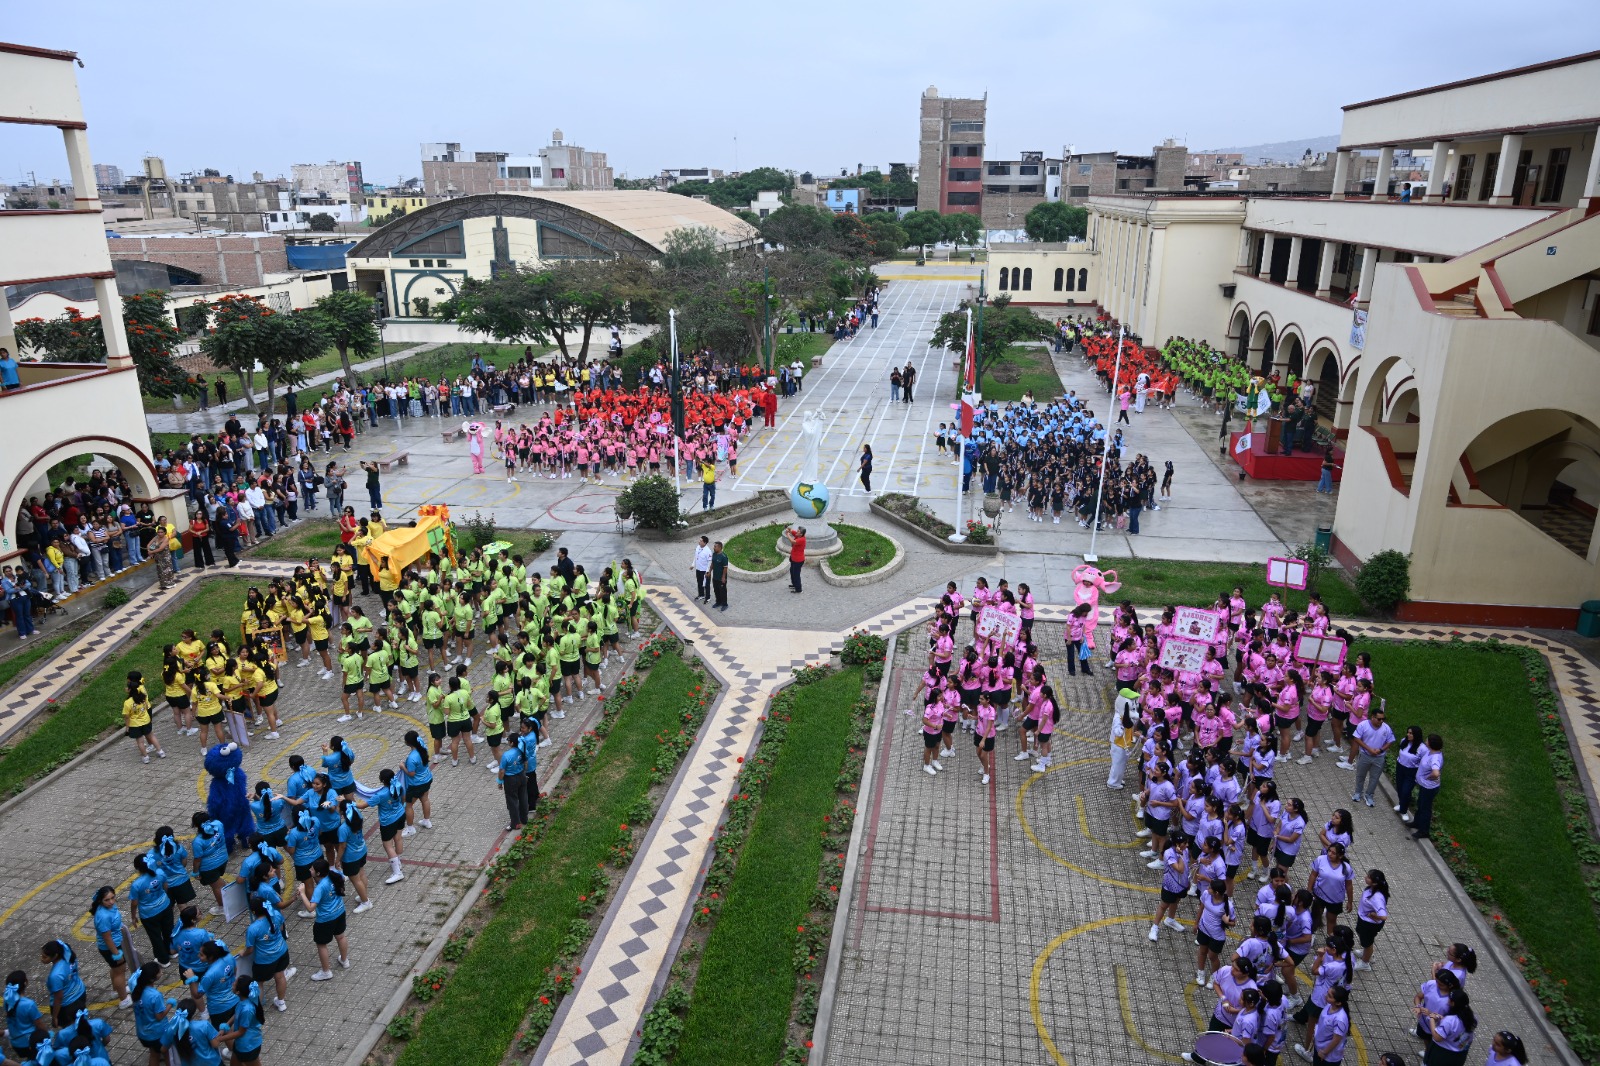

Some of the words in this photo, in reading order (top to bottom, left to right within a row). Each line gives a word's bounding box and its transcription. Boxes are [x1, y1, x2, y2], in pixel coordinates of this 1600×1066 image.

[2, 538, 9, 546] S
[1182, 611, 1213, 624] AJEDREZ
[1172, 644, 1199, 655] VOLEY
